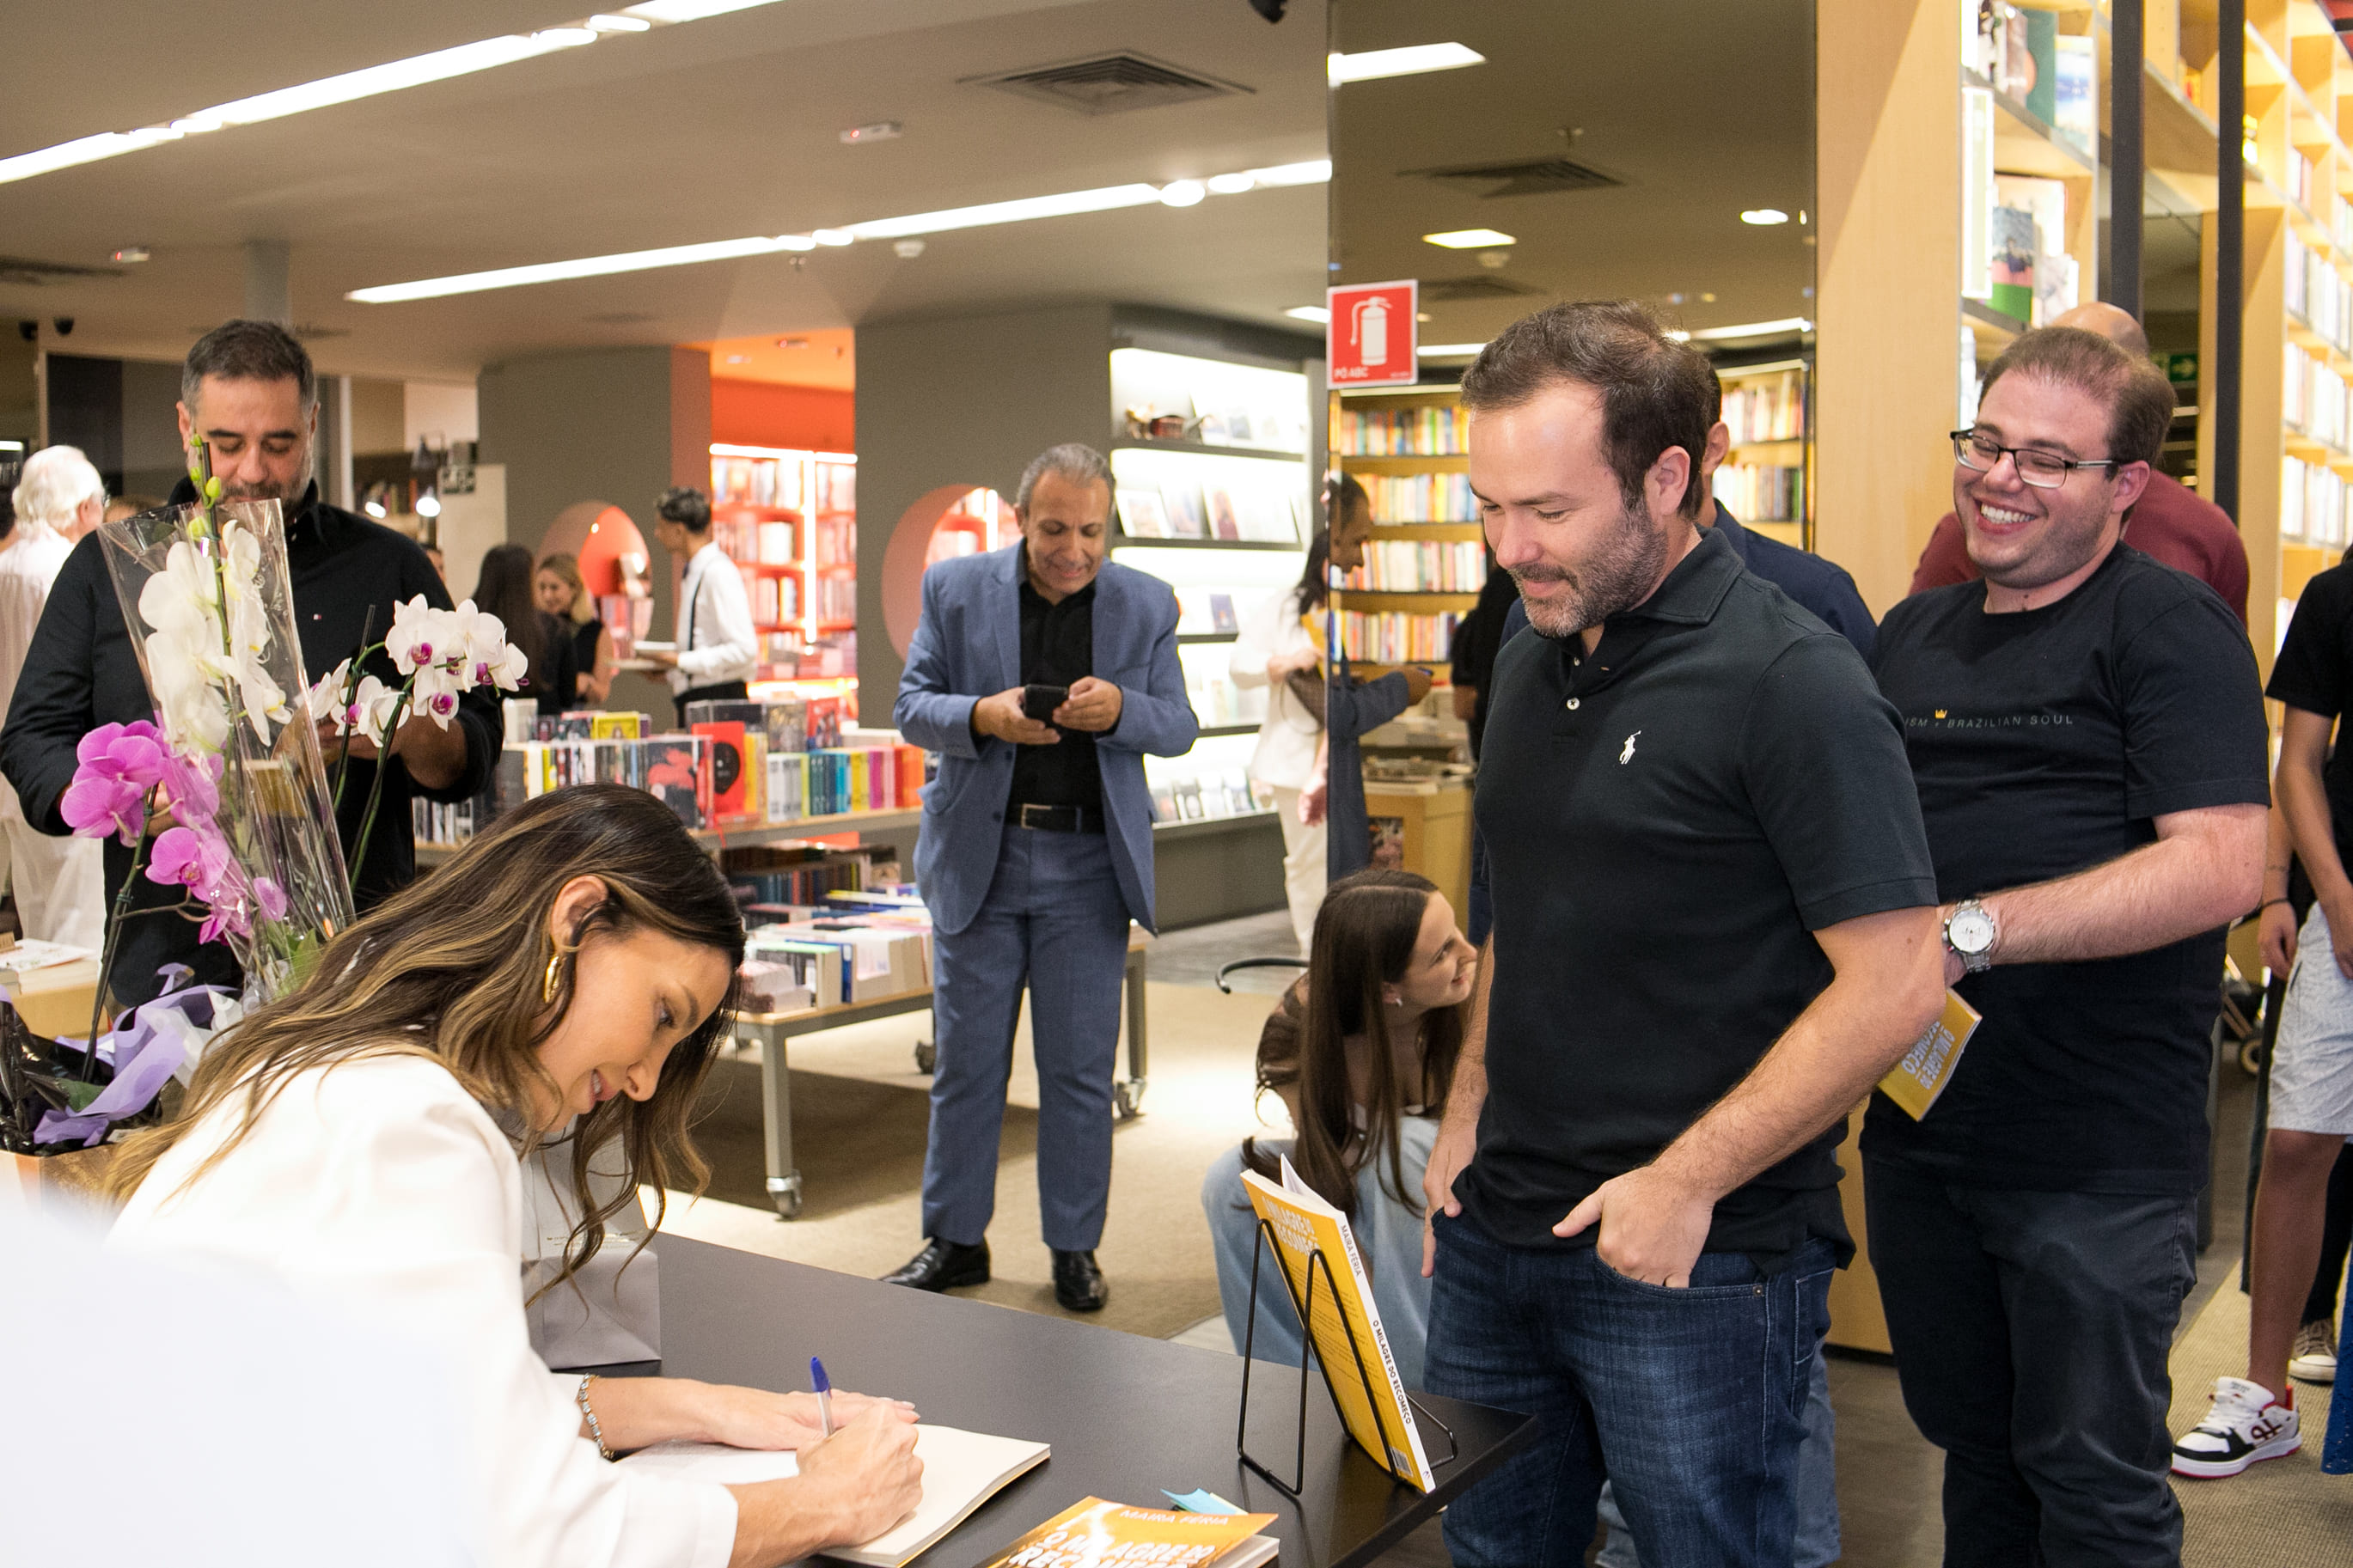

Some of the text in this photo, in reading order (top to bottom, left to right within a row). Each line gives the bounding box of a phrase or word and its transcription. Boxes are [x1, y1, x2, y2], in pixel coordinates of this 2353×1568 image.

[1947, 716, 2021, 729] BRAZILIAN
[2029, 714, 2074, 725] SOUL
[1376, 1328, 1392, 1365] MILAGRE
[1389, 1366, 1397, 1378] DO
[1392, 1379, 1412, 1425] RECOMEÇO
[1059, 1534, 1189, 1562] MAGRE
